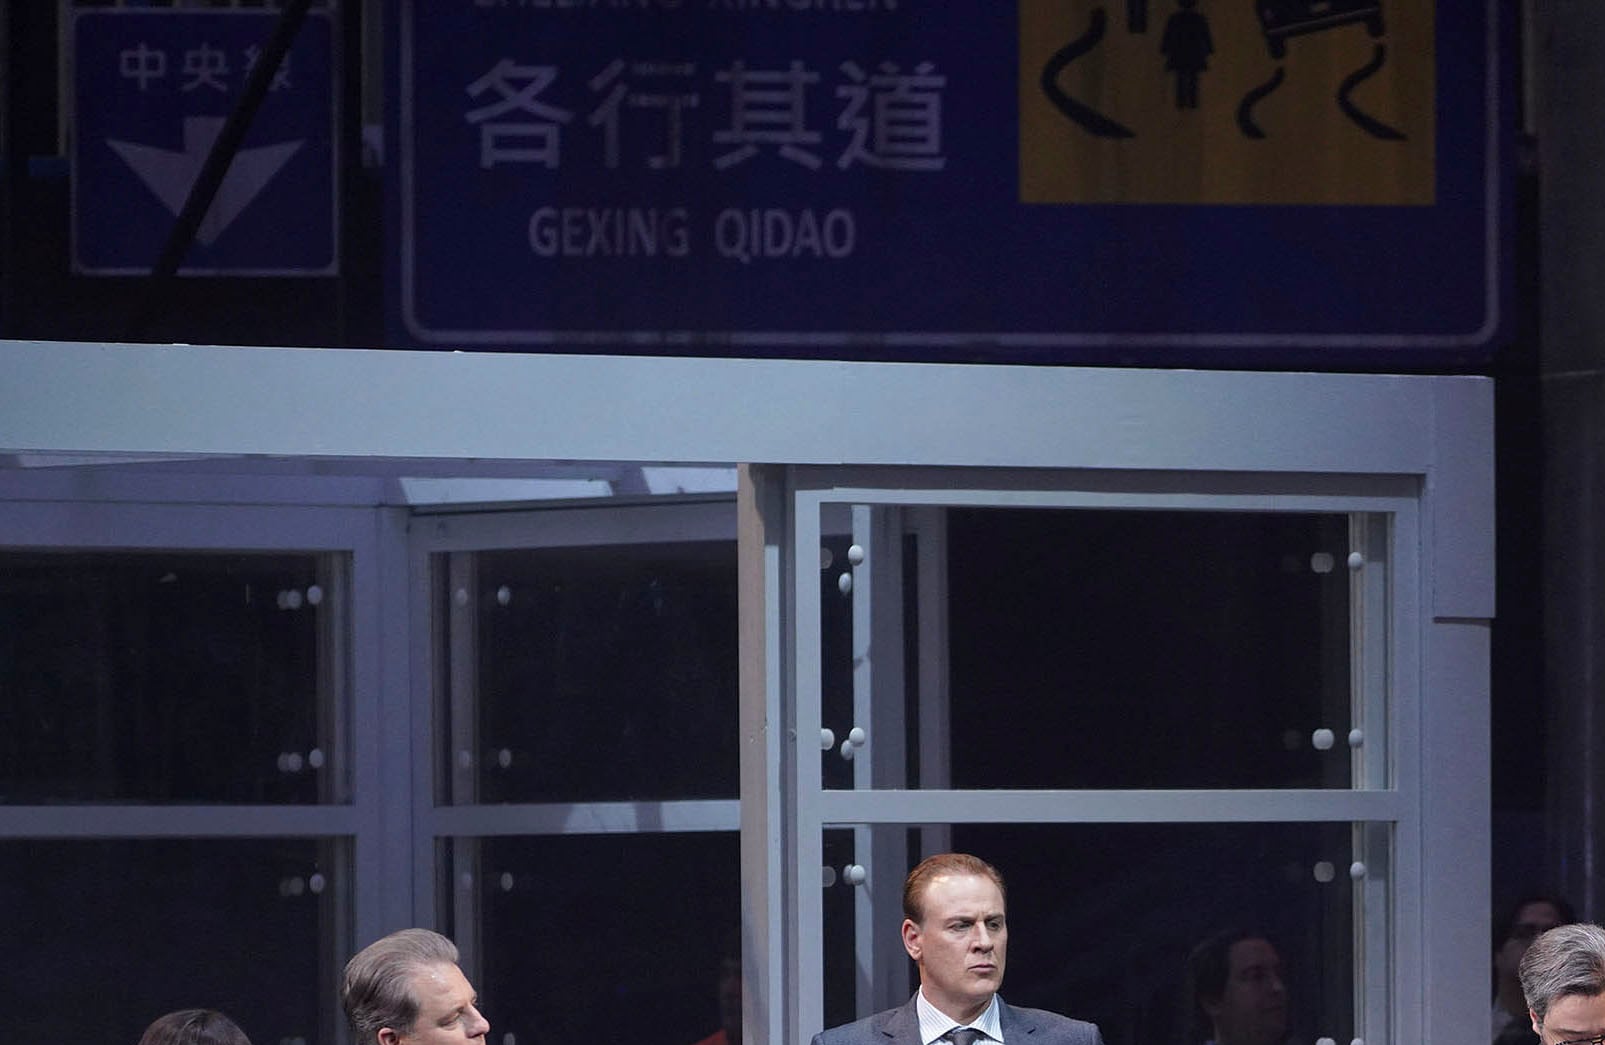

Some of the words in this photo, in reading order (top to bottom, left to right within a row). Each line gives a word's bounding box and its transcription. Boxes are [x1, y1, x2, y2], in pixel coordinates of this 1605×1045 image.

[464, 58, 947, 171] 各行其道
[528, 206, 690, 258] GEXING
[714, 206, 857, 265] QIDAO
